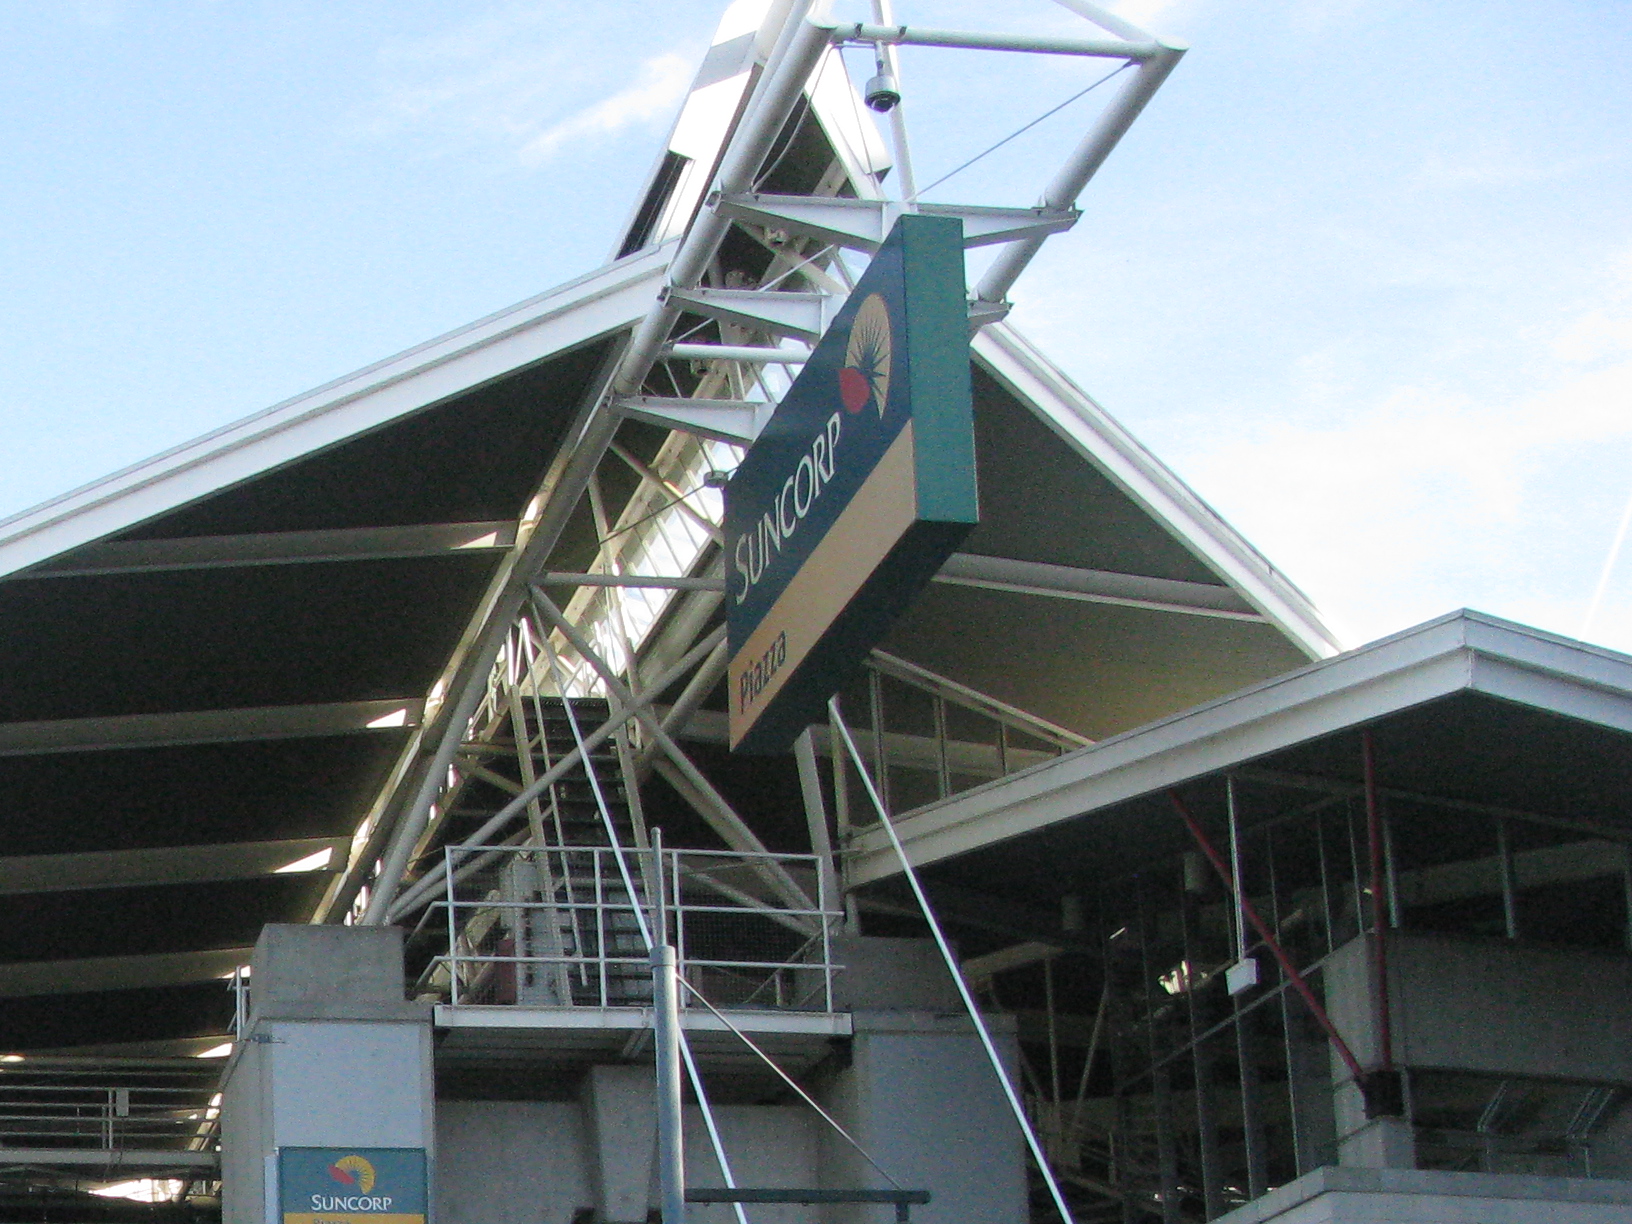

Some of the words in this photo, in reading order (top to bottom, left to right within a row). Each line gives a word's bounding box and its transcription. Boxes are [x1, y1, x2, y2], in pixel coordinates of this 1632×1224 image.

[735, 411, 842, 606] SUNCORP
[740, 629, 786, 715] Piazza
[311, 1194, 392, 1211] SUNCORP
